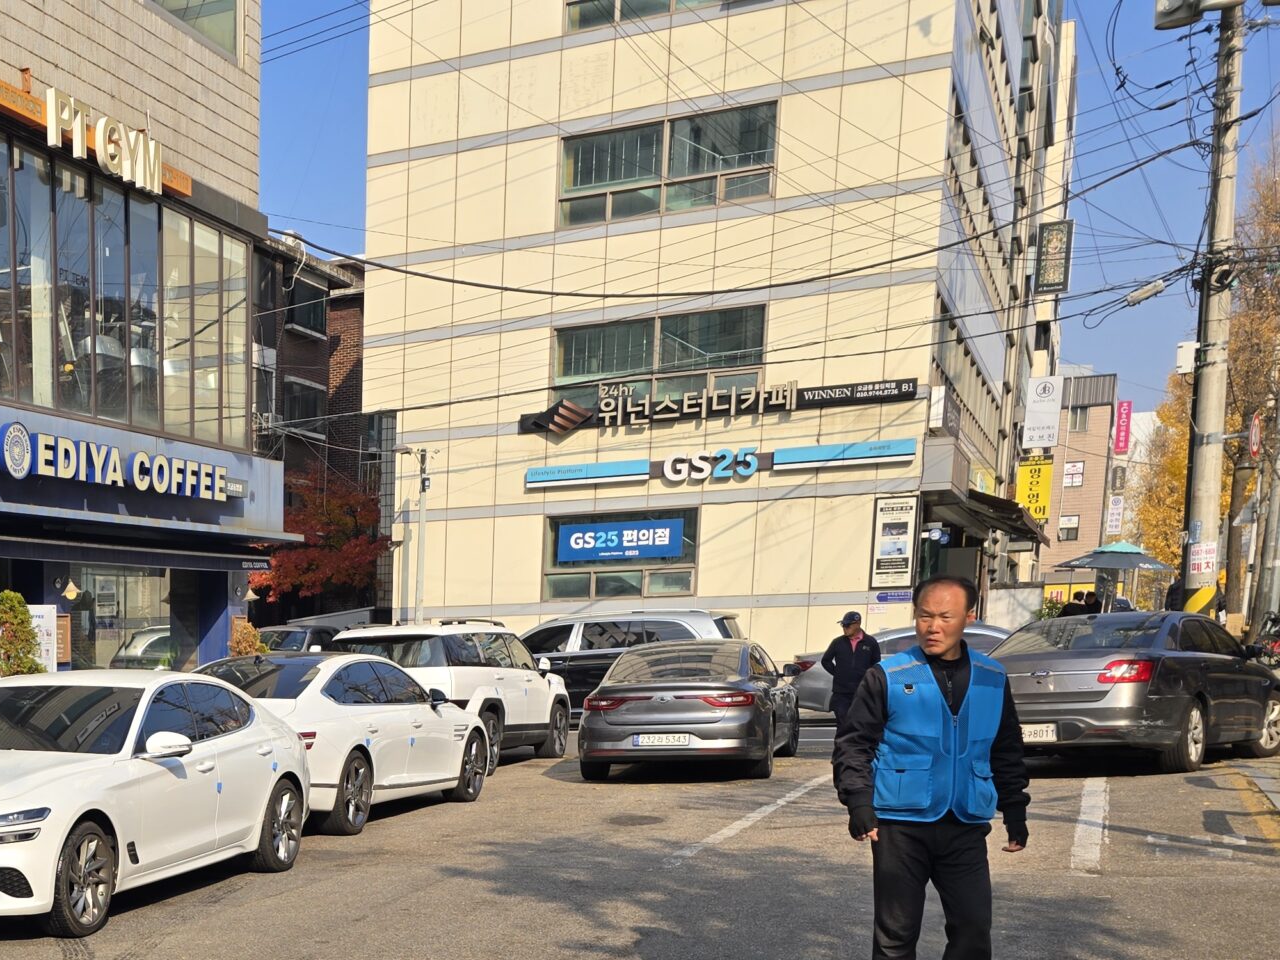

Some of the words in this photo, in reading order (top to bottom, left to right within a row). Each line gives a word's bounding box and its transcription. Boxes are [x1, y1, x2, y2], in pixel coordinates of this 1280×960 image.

[46, 87, 92, 159] PT
[95, 116, 162, 195] GYM
[599, 383, 637, 398] 24hr
[804, 387, 852, 400] WINNEN
[901, 382, 915, 392] B1
[35, 432, 125, 488] EDIYA
[130, 450, 228, 502] COFFEE
[663, 447, 759, 482] GS25
[569, 530, 619, 549] GS25
[622, 527, 670, 547] 편의점
